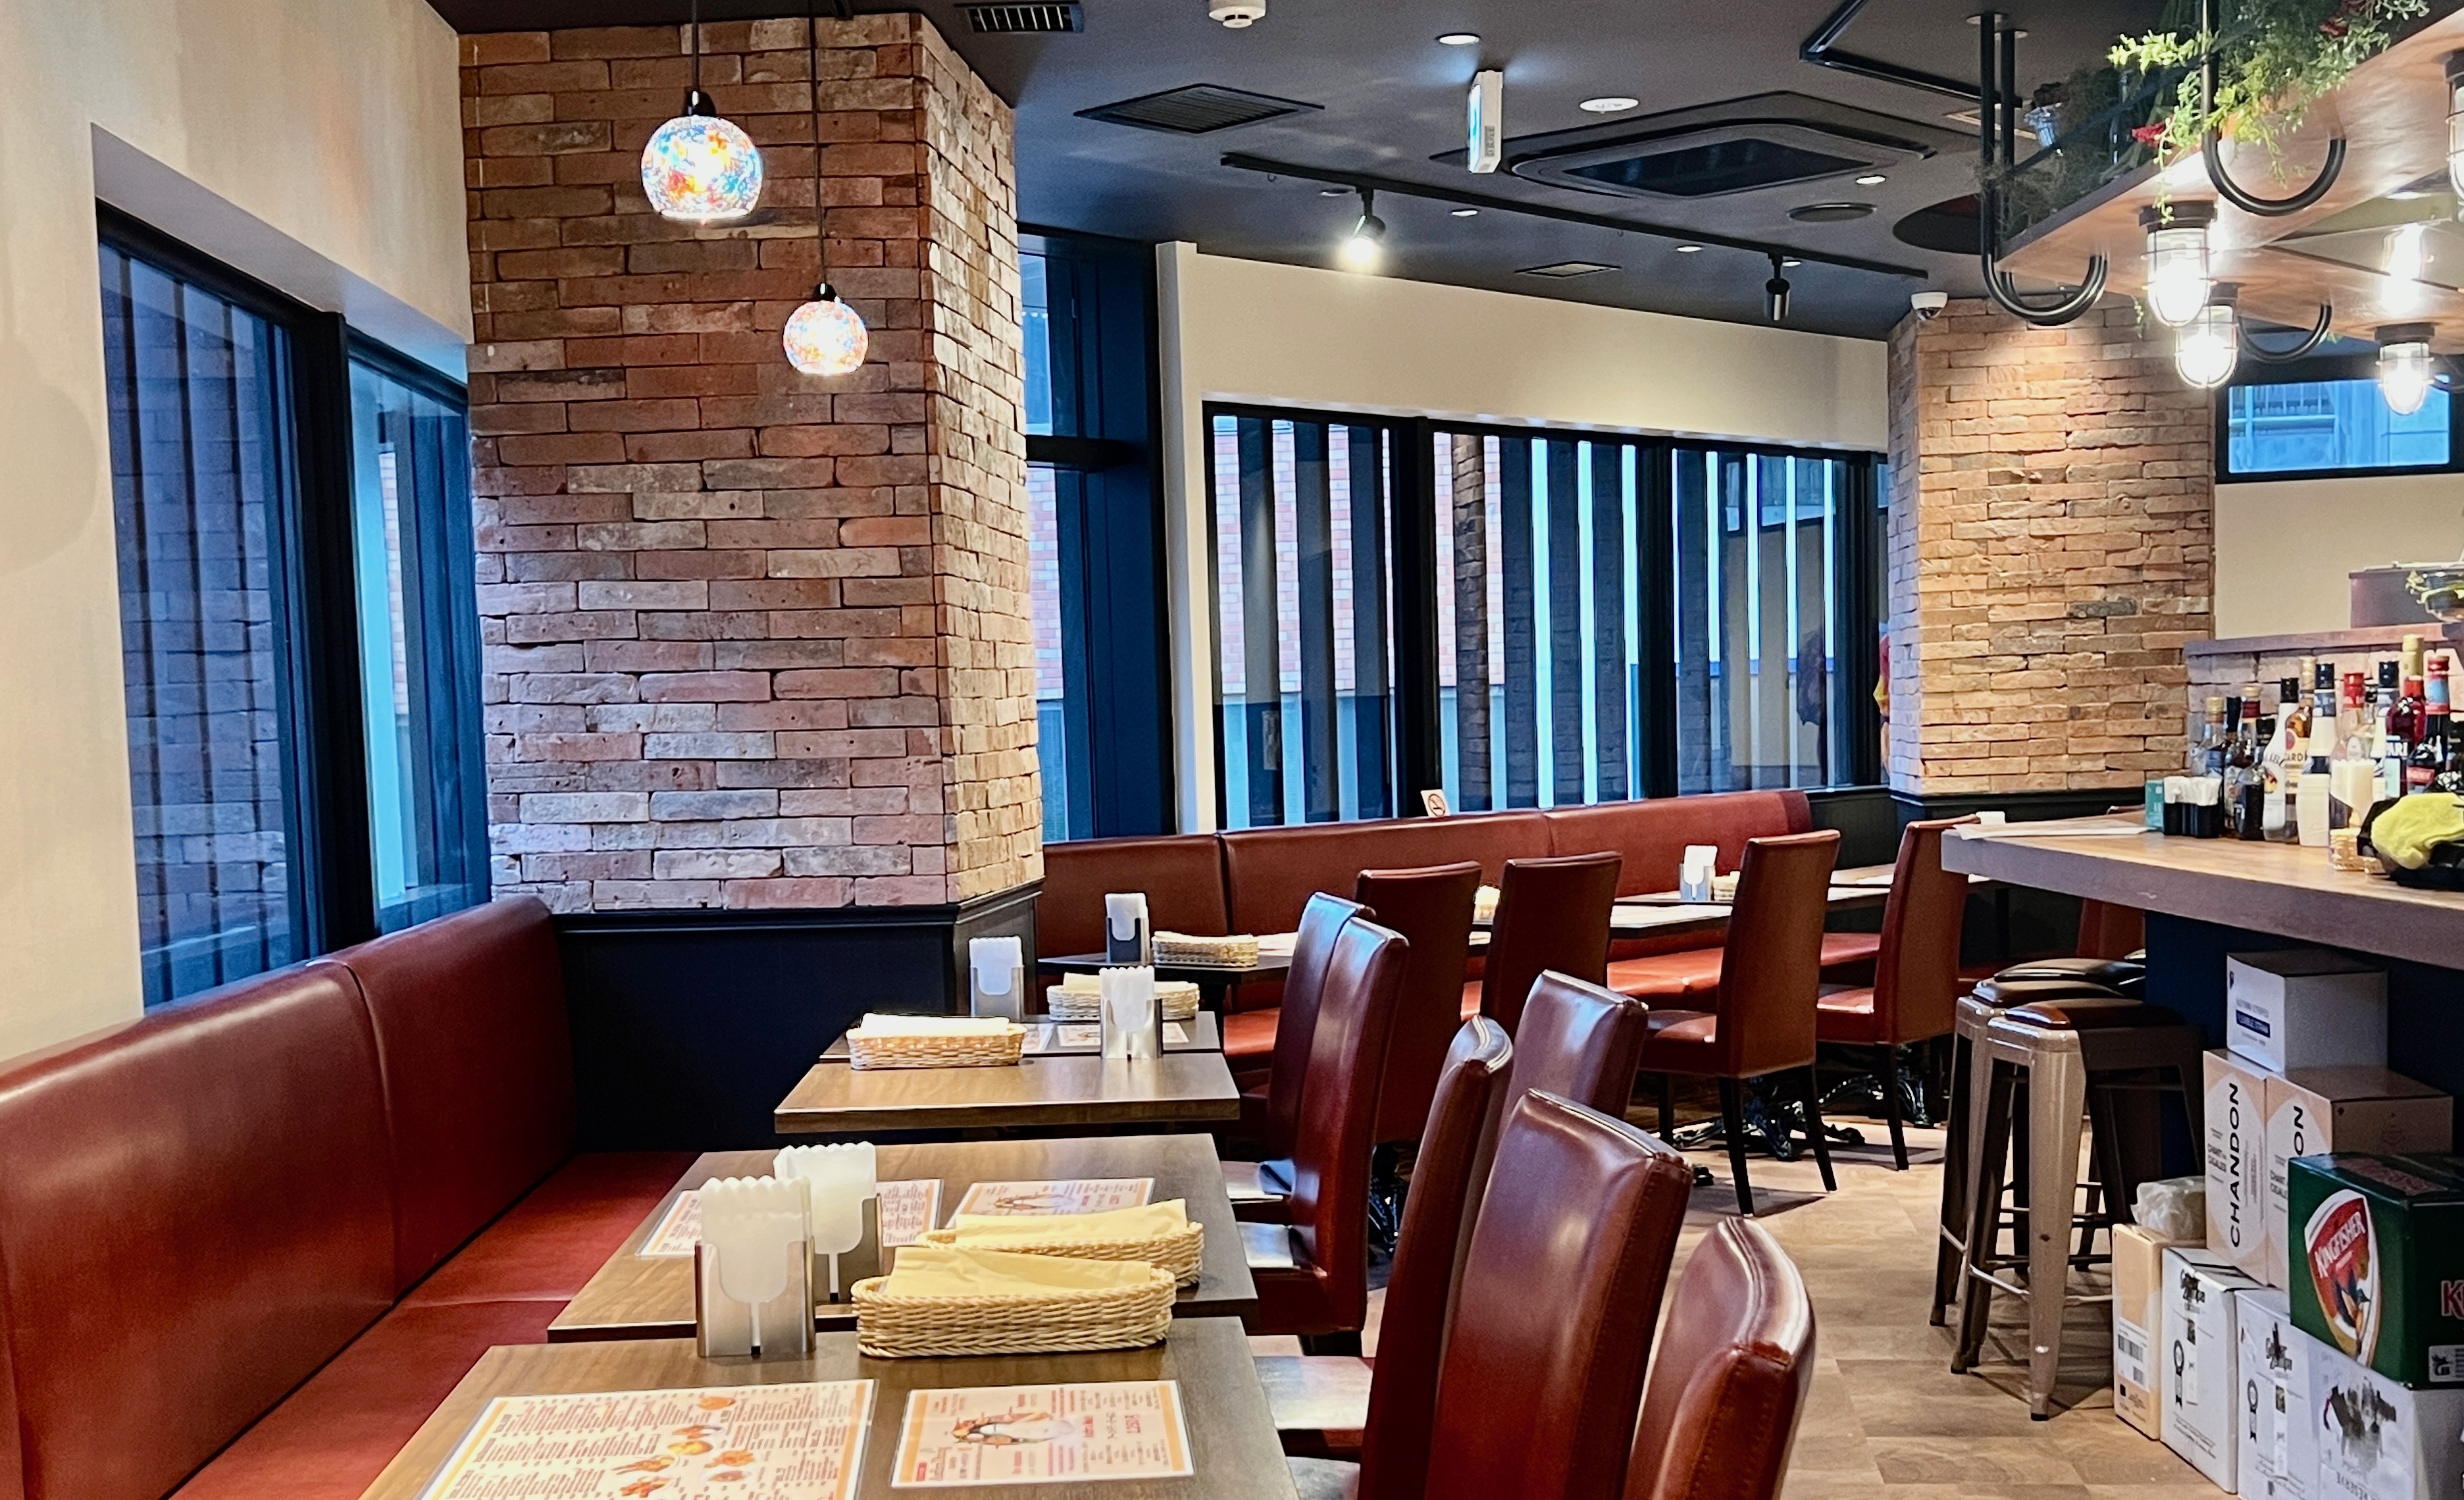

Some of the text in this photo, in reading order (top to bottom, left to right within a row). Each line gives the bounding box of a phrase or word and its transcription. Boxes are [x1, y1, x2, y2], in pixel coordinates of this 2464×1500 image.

[2386, 742, 2408, 756] ARI
[2294, 1106, 2303, 1156] ON
[2229, 1083, 2240, 1247] CHANDON
[2314, 1211, 2366, 1279] KINGFISHER
[2441, 1280, 2464, 1321] K
